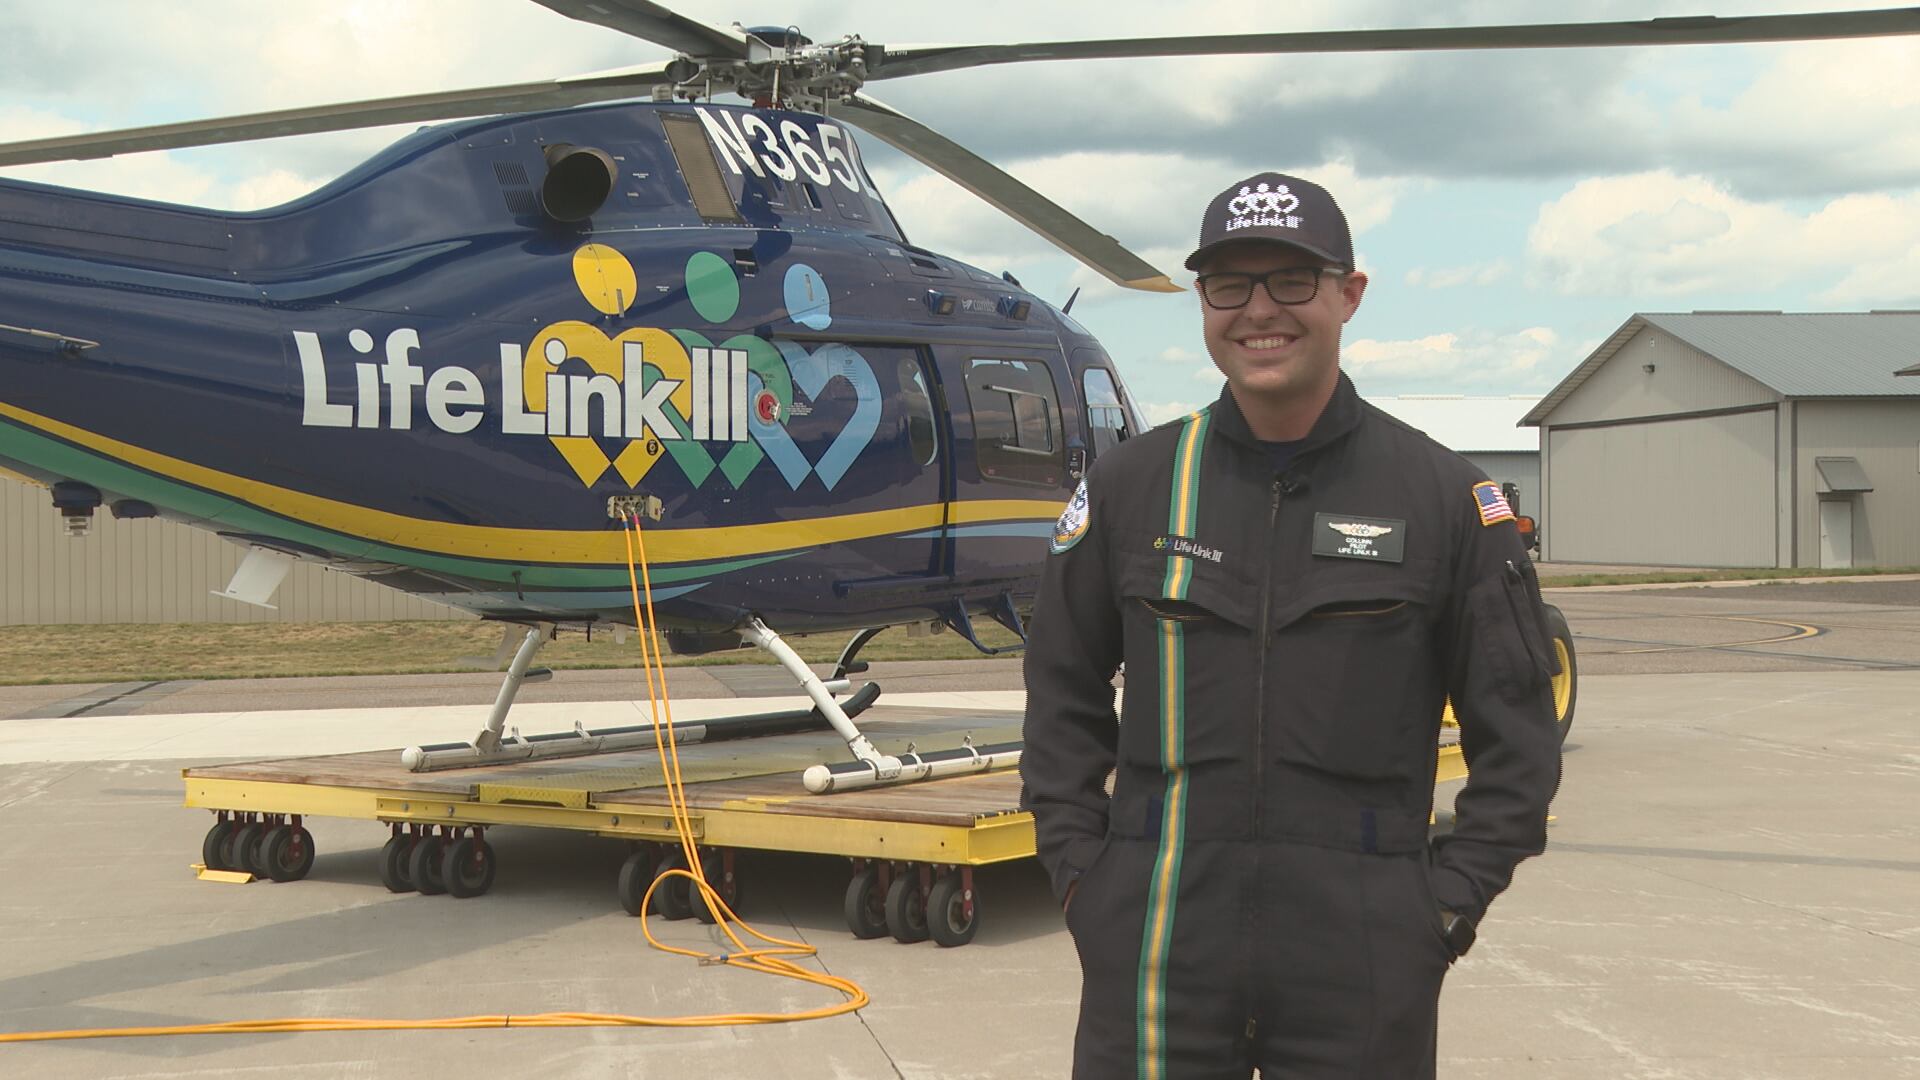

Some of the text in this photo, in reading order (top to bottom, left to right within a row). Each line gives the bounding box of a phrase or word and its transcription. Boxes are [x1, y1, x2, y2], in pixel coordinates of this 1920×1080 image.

[1225, 216, 1252, 232] Life
[1252, 213, 1285, 227] Link
[293, 328, 748, 442] Life Link III
[1173, 539, 1192, 552] Life
[1192, 543, 1212, 559] Link
